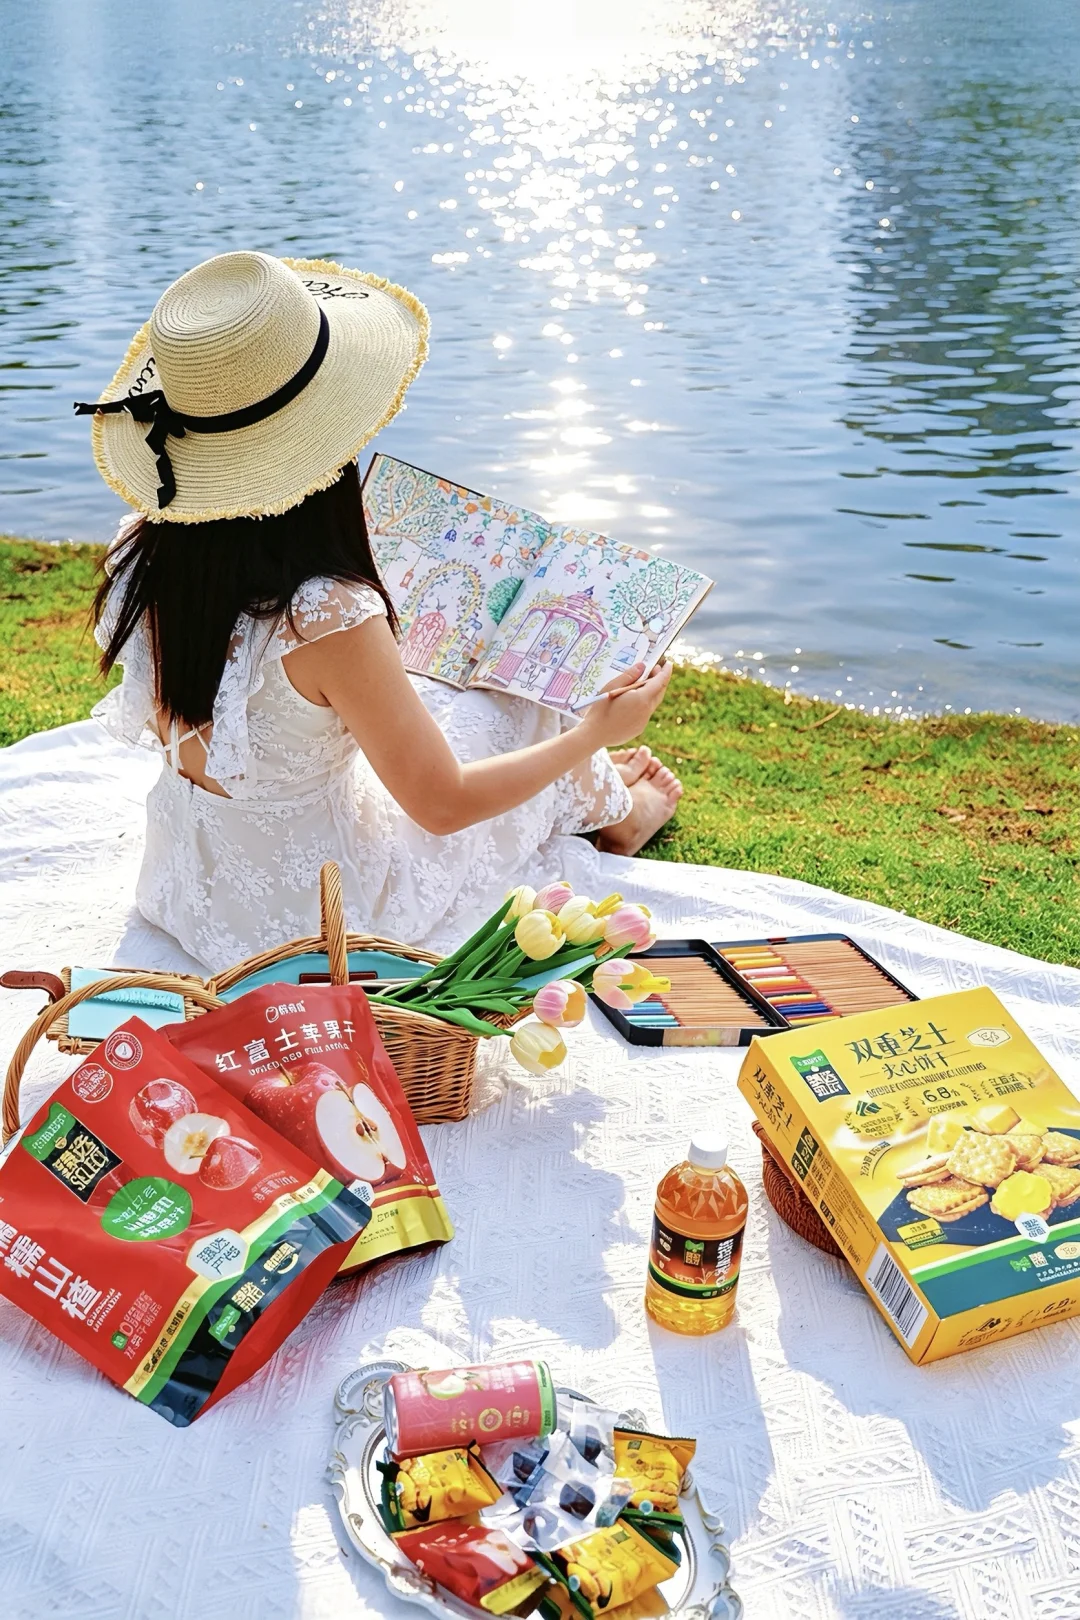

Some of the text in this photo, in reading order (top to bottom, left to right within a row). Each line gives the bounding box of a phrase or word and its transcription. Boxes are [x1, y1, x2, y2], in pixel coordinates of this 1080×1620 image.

[215, 1020, 356, 1073] 红富士苹果干
[844, 1022, 955, 1065] 双重芝士
[882, 1051, 949, 1080] 夹心饼干
